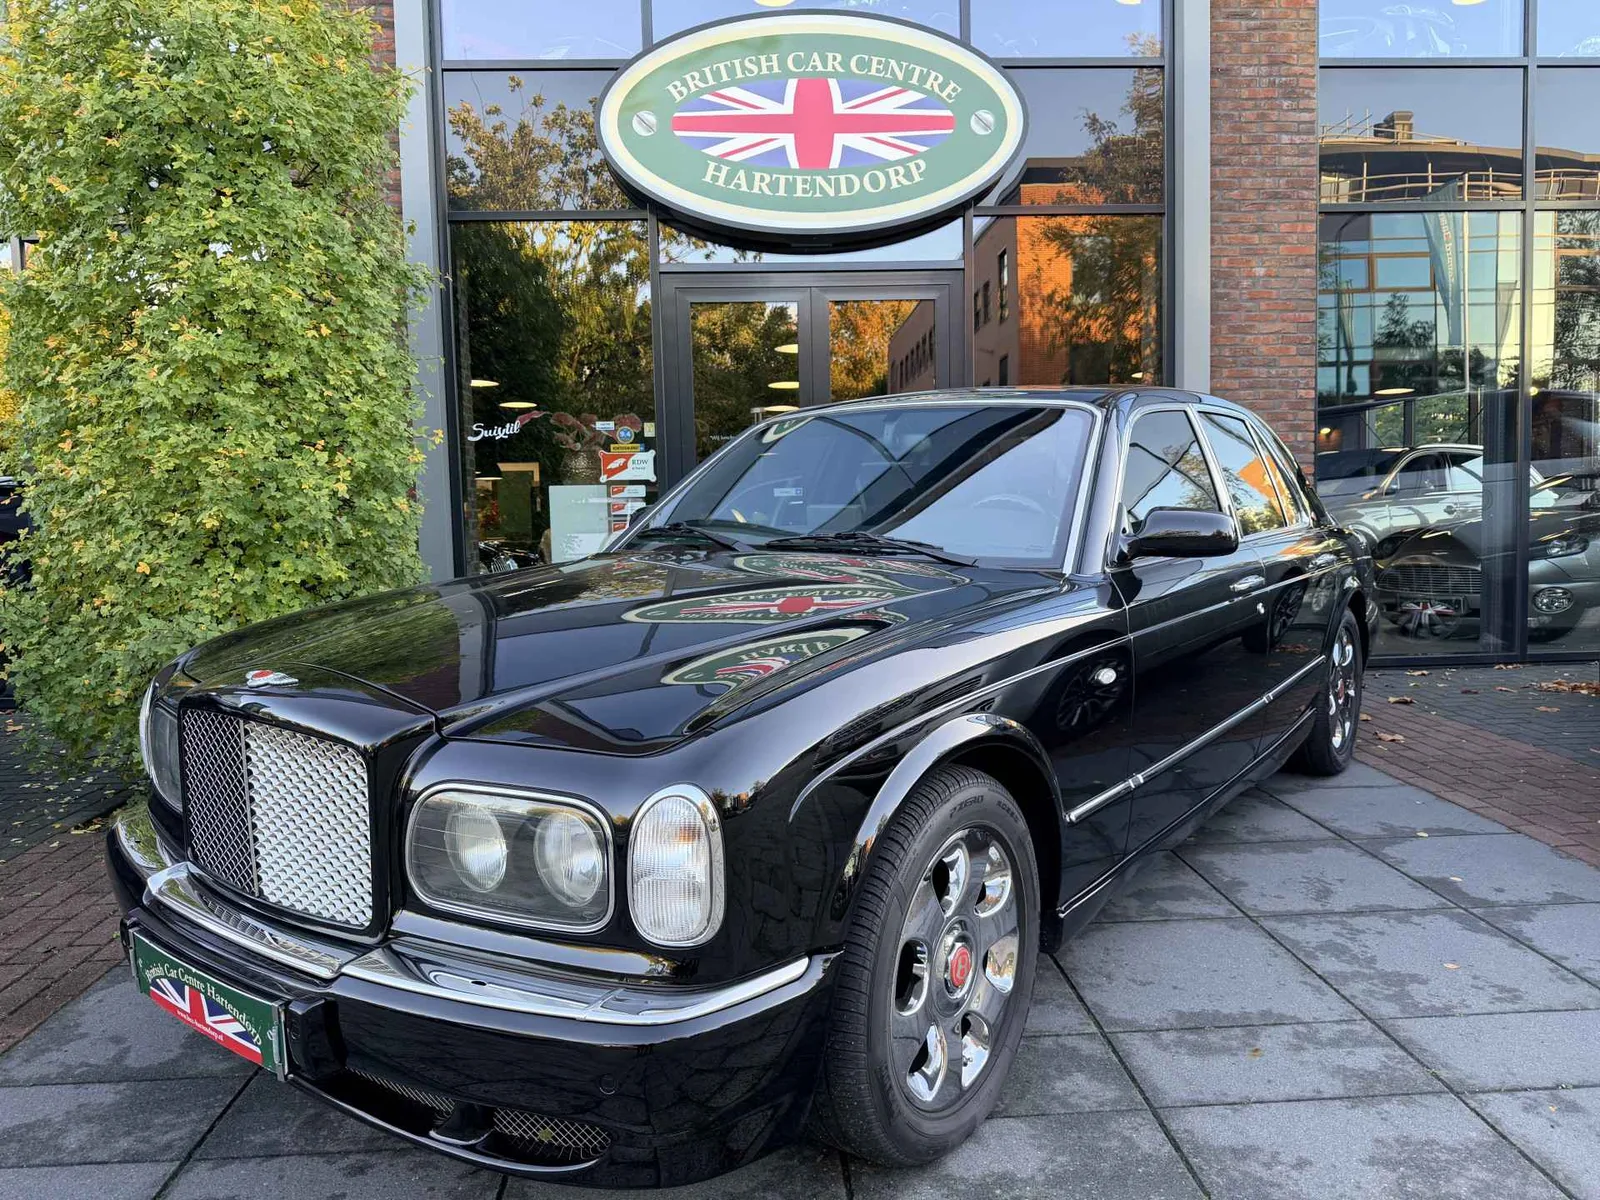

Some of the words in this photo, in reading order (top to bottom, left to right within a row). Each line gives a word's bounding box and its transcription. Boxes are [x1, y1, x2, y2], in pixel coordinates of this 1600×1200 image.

[666, 53, 780, 104] BRITISH
[786, 51, 845, 74] CAR
[849, 53, 963, 104] CENTRE
[702, 158, 928, 198] HARTENDORP
[145, 962, 165, 983] British
[164, 963, 178, 978] Car
[178, 967, 205, 992] Centre
[206, 982, 262, 1045] Hartendorp
